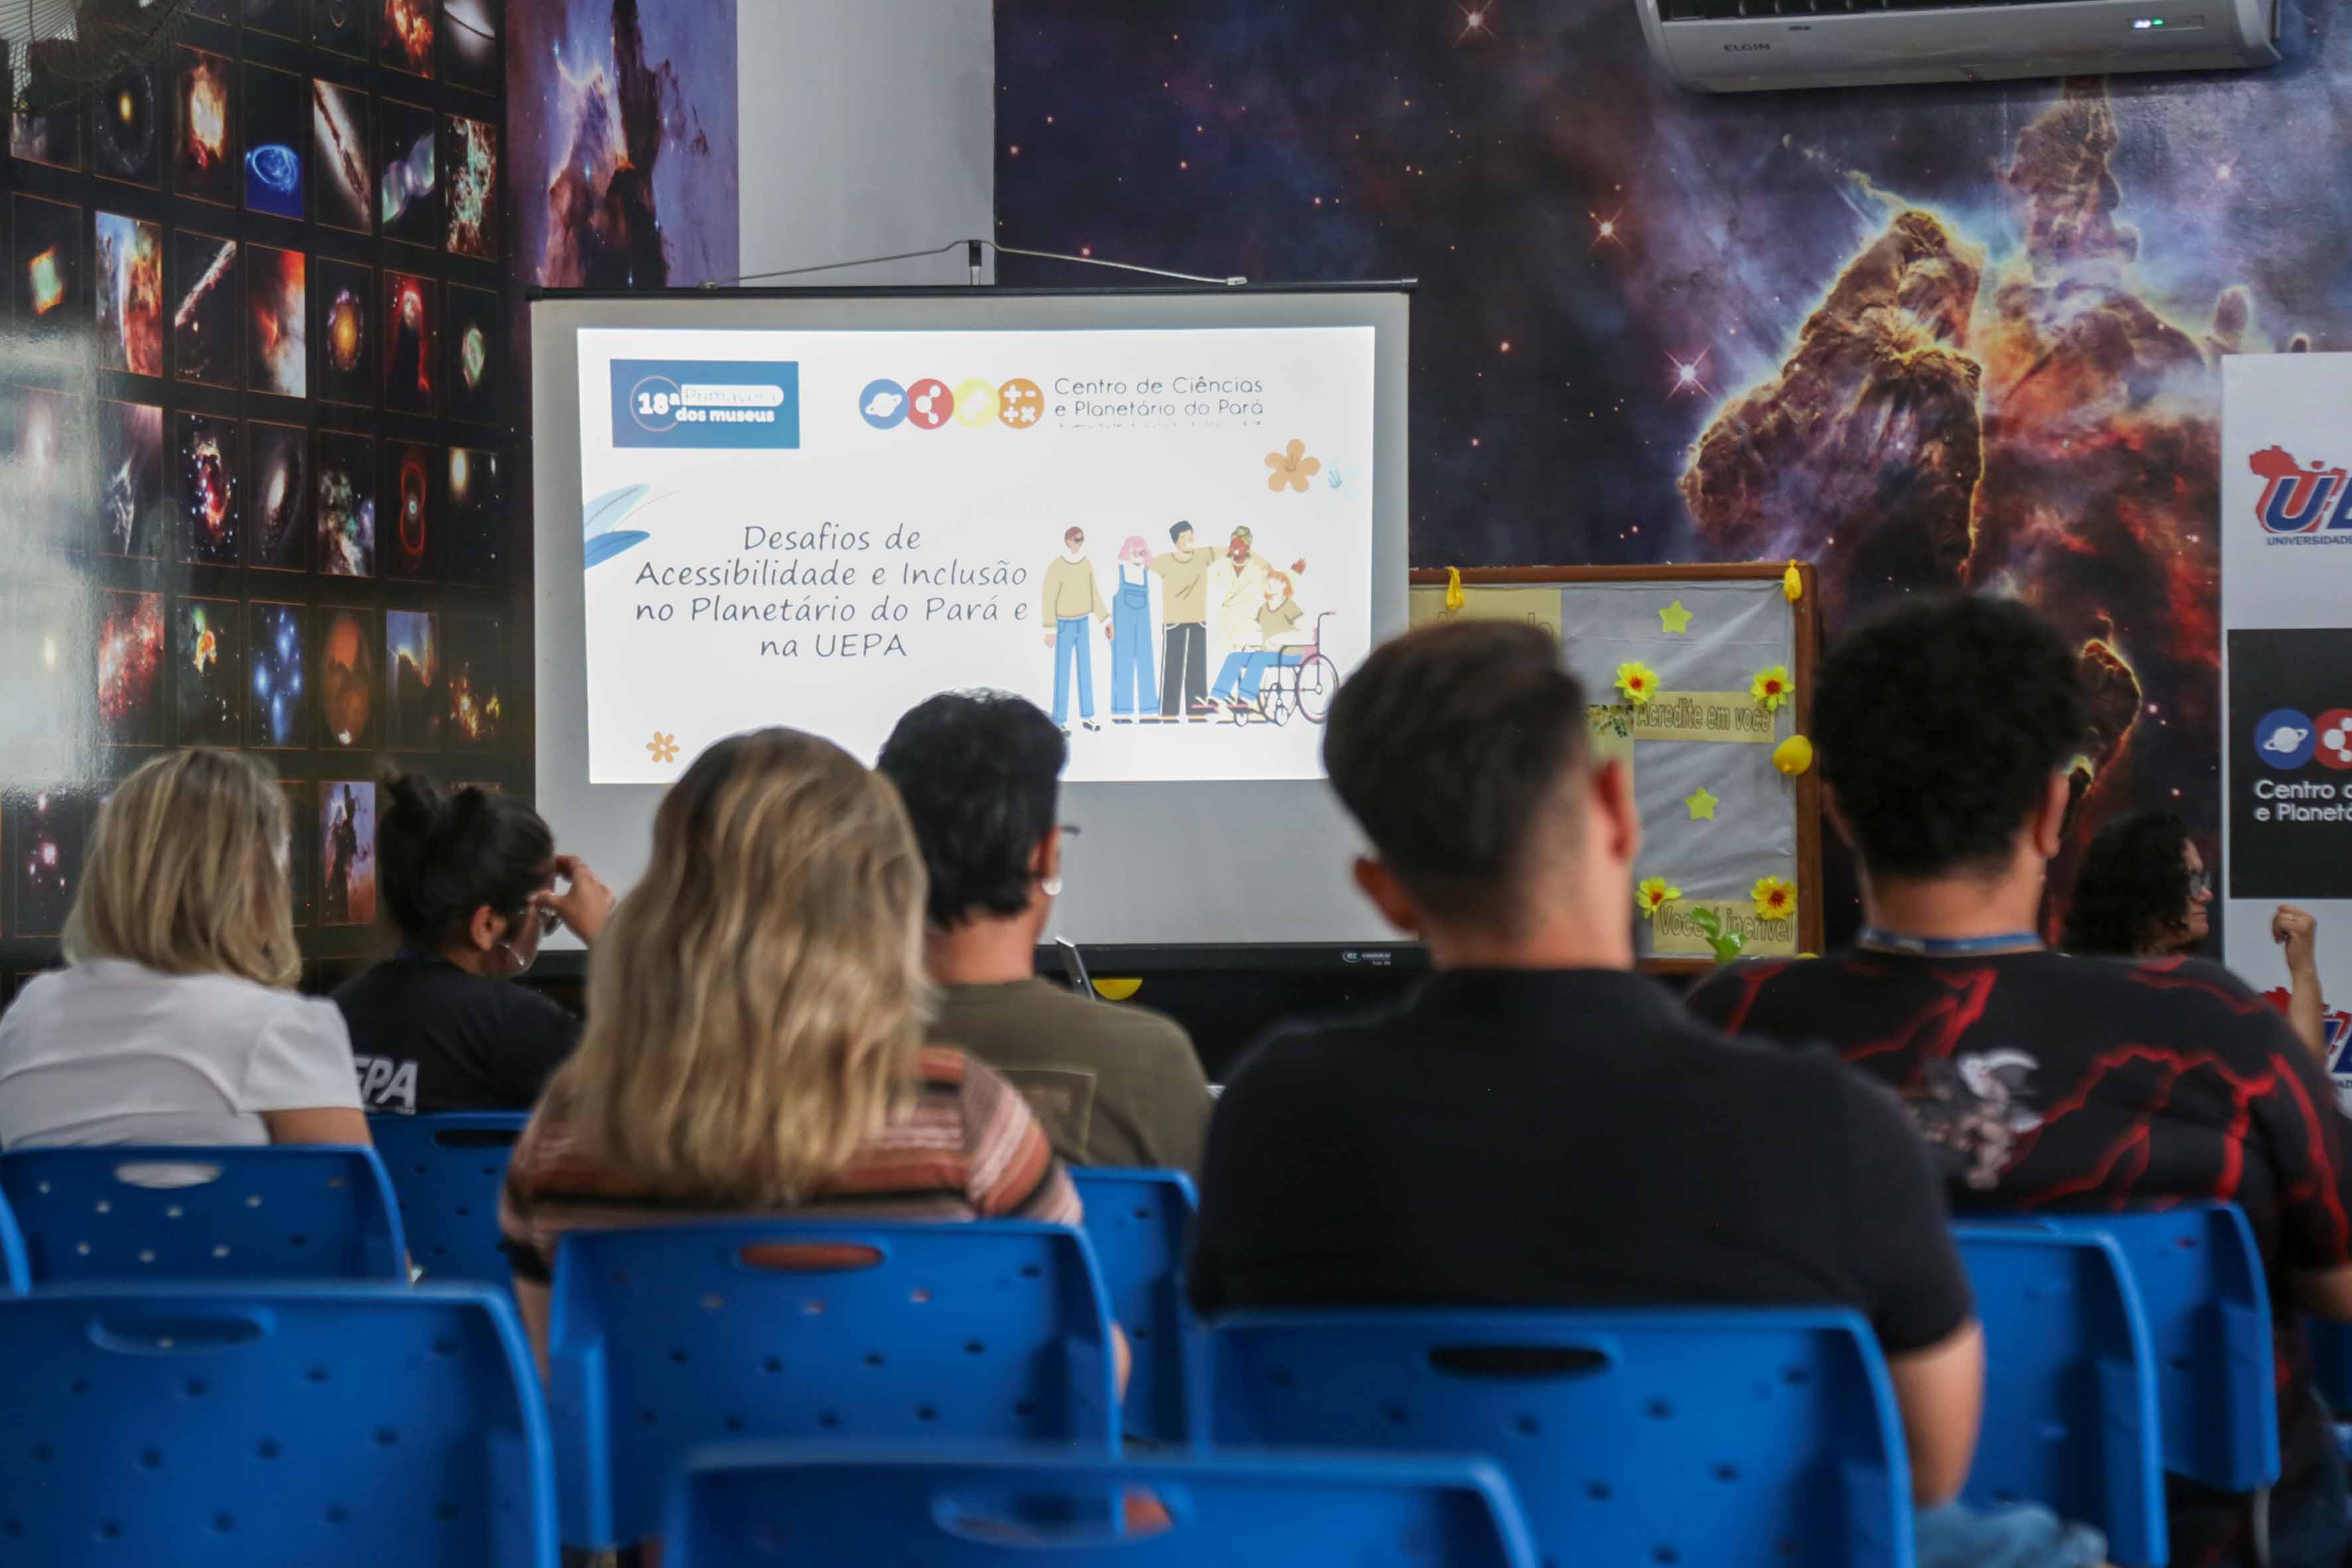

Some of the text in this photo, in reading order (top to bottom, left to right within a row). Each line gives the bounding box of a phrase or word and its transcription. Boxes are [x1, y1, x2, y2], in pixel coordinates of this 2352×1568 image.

[1054, 376, 1263, 394] Centro de Ciências
[675, 407, 775, 423] dos museus
[1054, 398, 1263, 417] e Planetário do Pará
[743, 522, 921, 551] Desafios de
[635, 559, 1028, 587] Acessibilidade e Inclusão
[635, 593, 1028, 622] no Planetário do Pará e
[760, 633, 907, 658] na UEPA
[1636, 697, 1703, 730] Acredite
[1707, 705, 1731, 731] em
[2254, 779, 2336, 799] Centro
[2255, 806, 2271, 822] e
